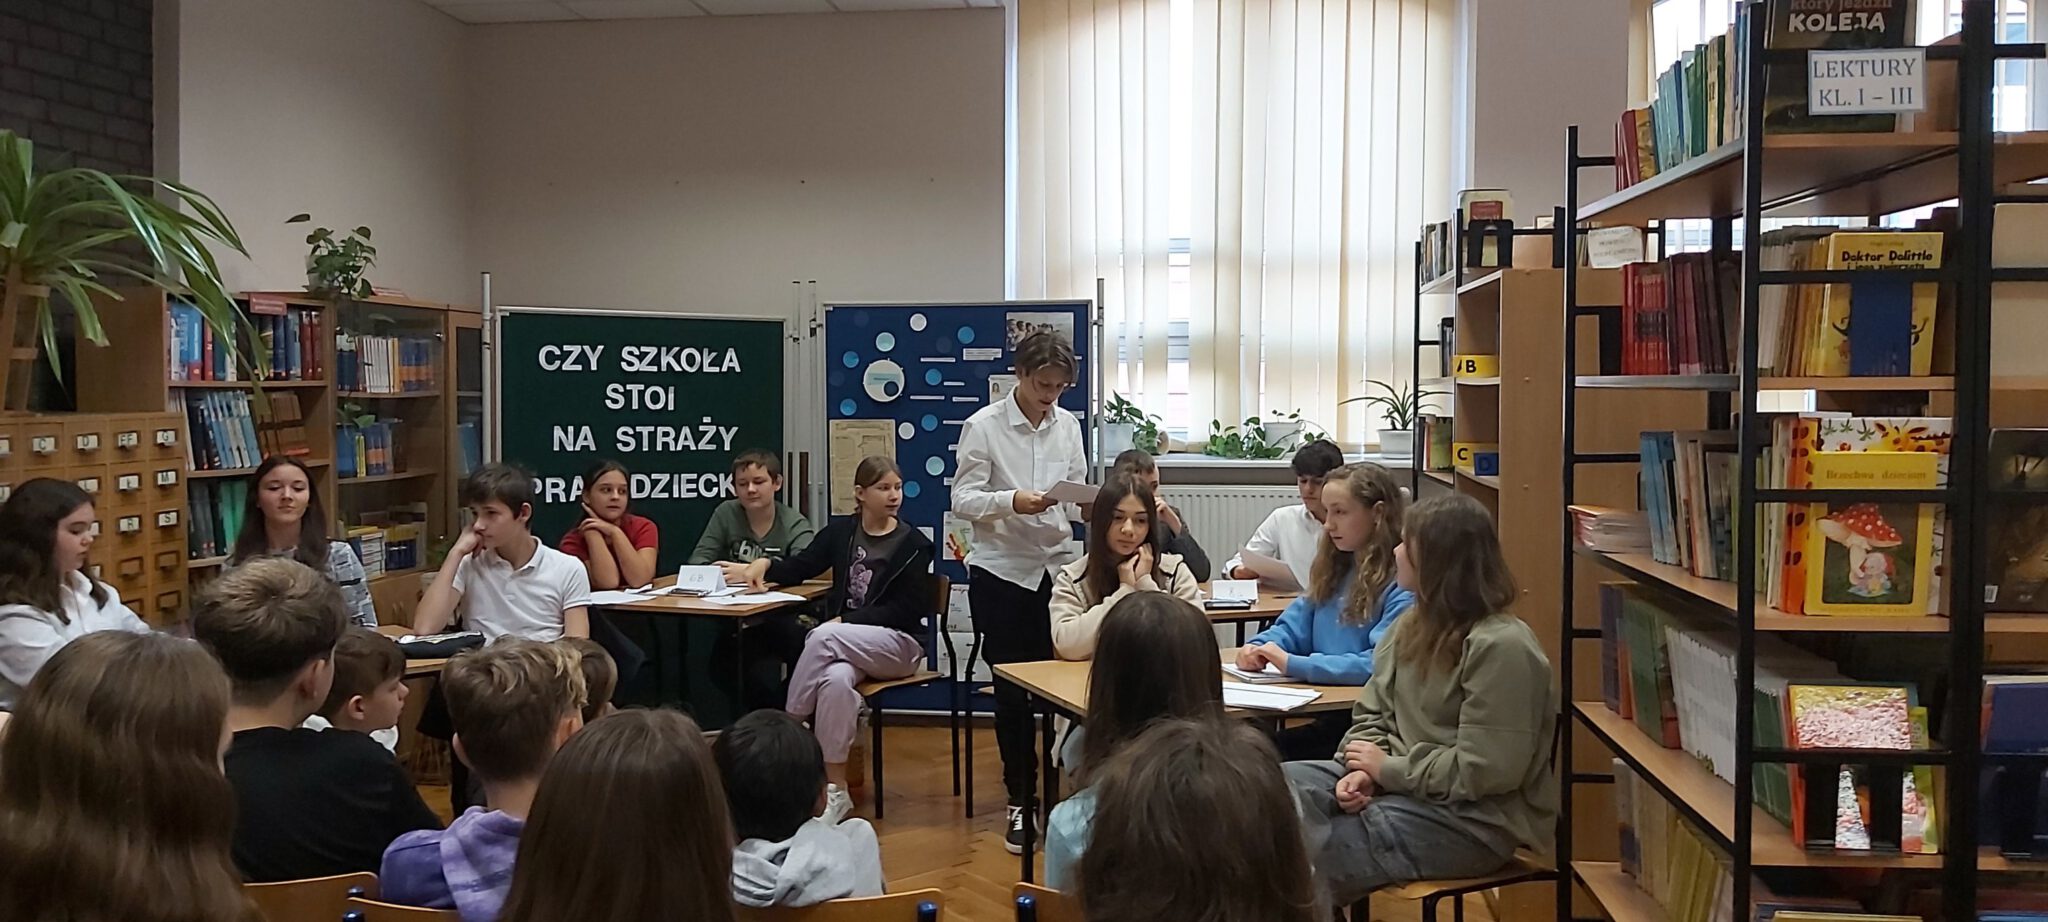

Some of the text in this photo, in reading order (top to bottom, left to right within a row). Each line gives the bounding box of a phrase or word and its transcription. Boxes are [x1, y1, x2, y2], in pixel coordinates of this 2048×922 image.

[1813, 58, 1917, 78] LEKTURY
[1819, 89, 1852, 106] KL.
[1858, 88, 1864, 105] I
[1890, 87, 1912, 105] III
[1842, 249, 1933, 262] Doktor Dolittle
[538, 345, 741, 372] CZY SZKOŁA
[1465, 359, 1477, 373] B
[605, 383, 675, 411] STOI
[162, 432, 169, 441] G
[553, 416, 739, 452] NA STRAŻY
[39, 438, 47, 450] C
[82, 436, 90, 447] D
[1457, 447, 1469, 460] C
[161, 472, 170, 482] M
[532, 473, 738, 503] RA DZIECK
[164, 513, 171, 523] S
